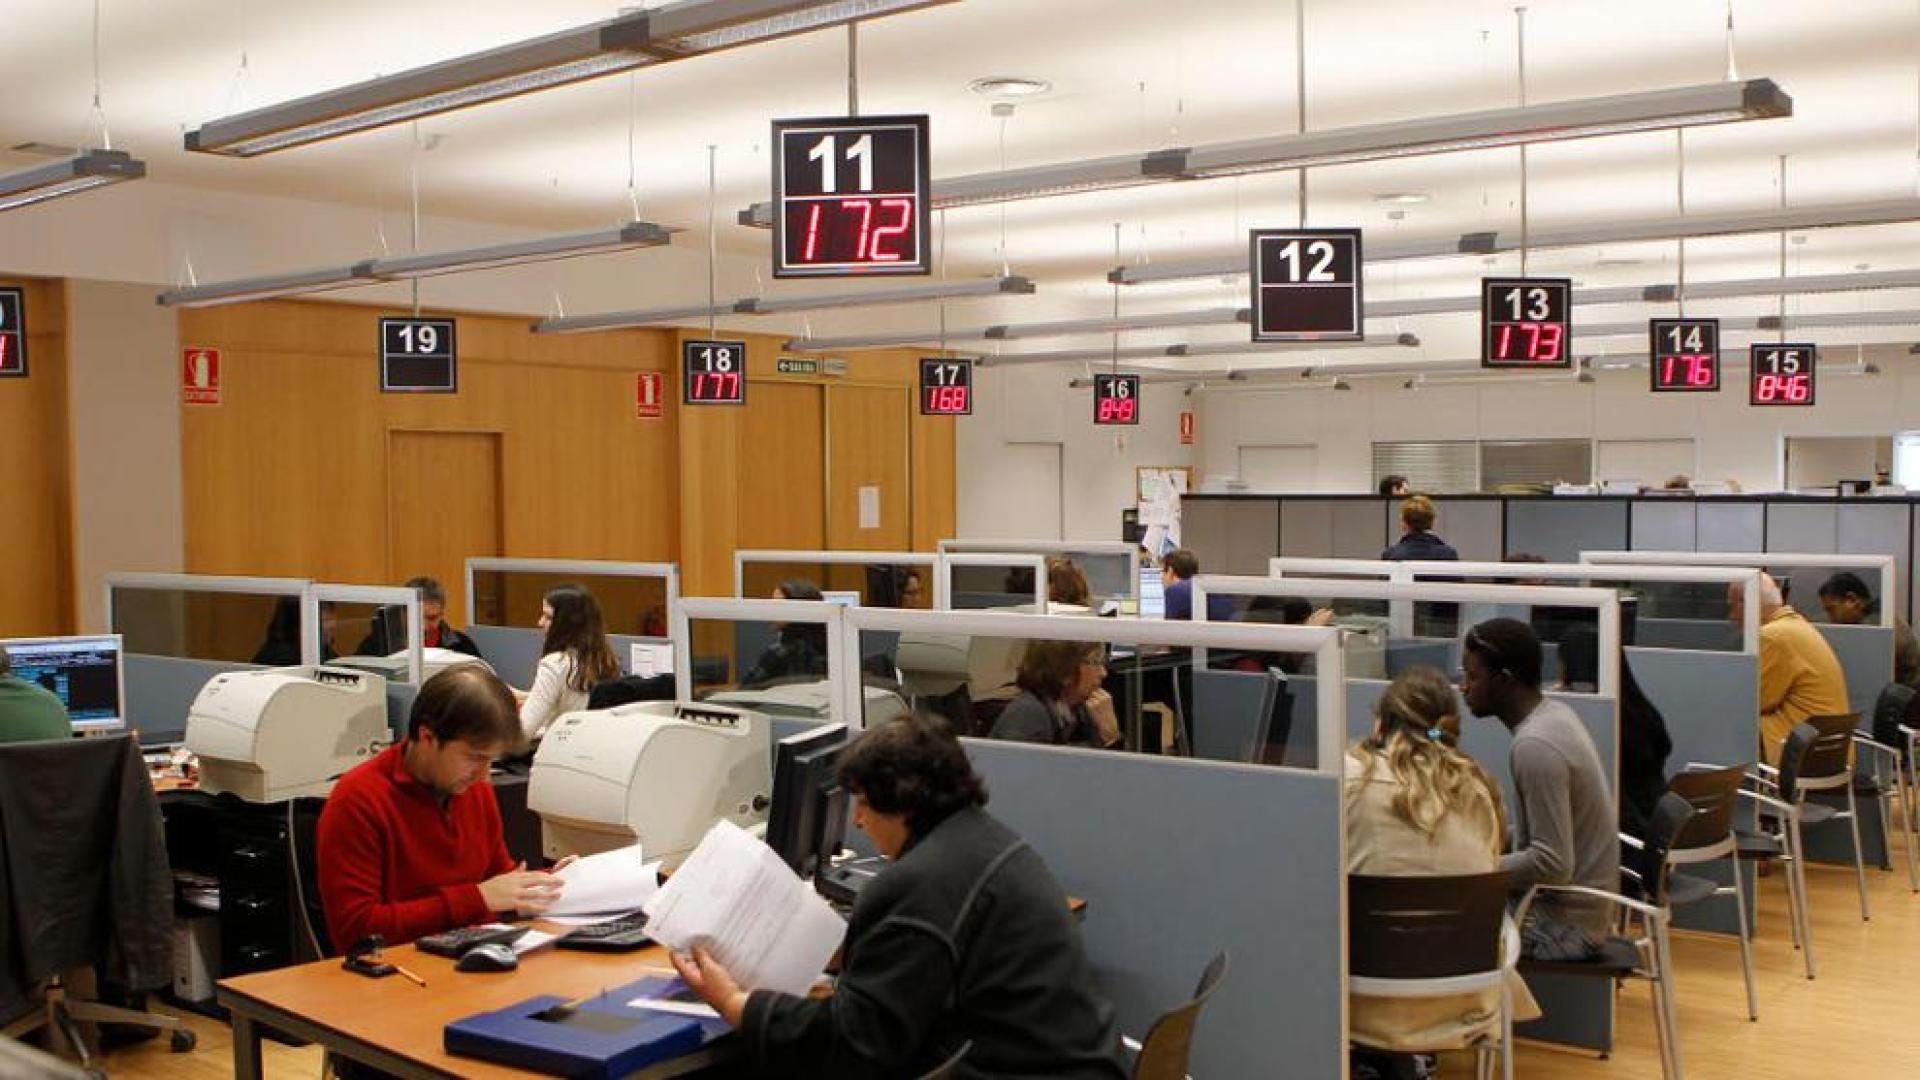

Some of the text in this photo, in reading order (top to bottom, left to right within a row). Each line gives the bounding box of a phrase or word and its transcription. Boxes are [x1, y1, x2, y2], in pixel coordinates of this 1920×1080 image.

[809, 134, 873, 192] 11
[805, 199, 911, 261] 172
[1279, 241, 1335, 282] 12
[1505, 287, 1550, 321] 13
[399, 325, 437, 353] 19
[1499, 323, 1562, 360] 173
[1668, 325, 1704, 352] 14
[700, 348, 732, 372] 18
[1663, 355, 1712, 385] 176
[1767, 351, 1799, 374] 15
[693, 373, 739, 398] 177
[934, 365, 959, 386] 17
[1758, 375, 1809, 401] 846
[930, 387, 965, 411] 168
[1107, 380, 1129, 399] 16
[1100, 399, 1134, 421] 849
